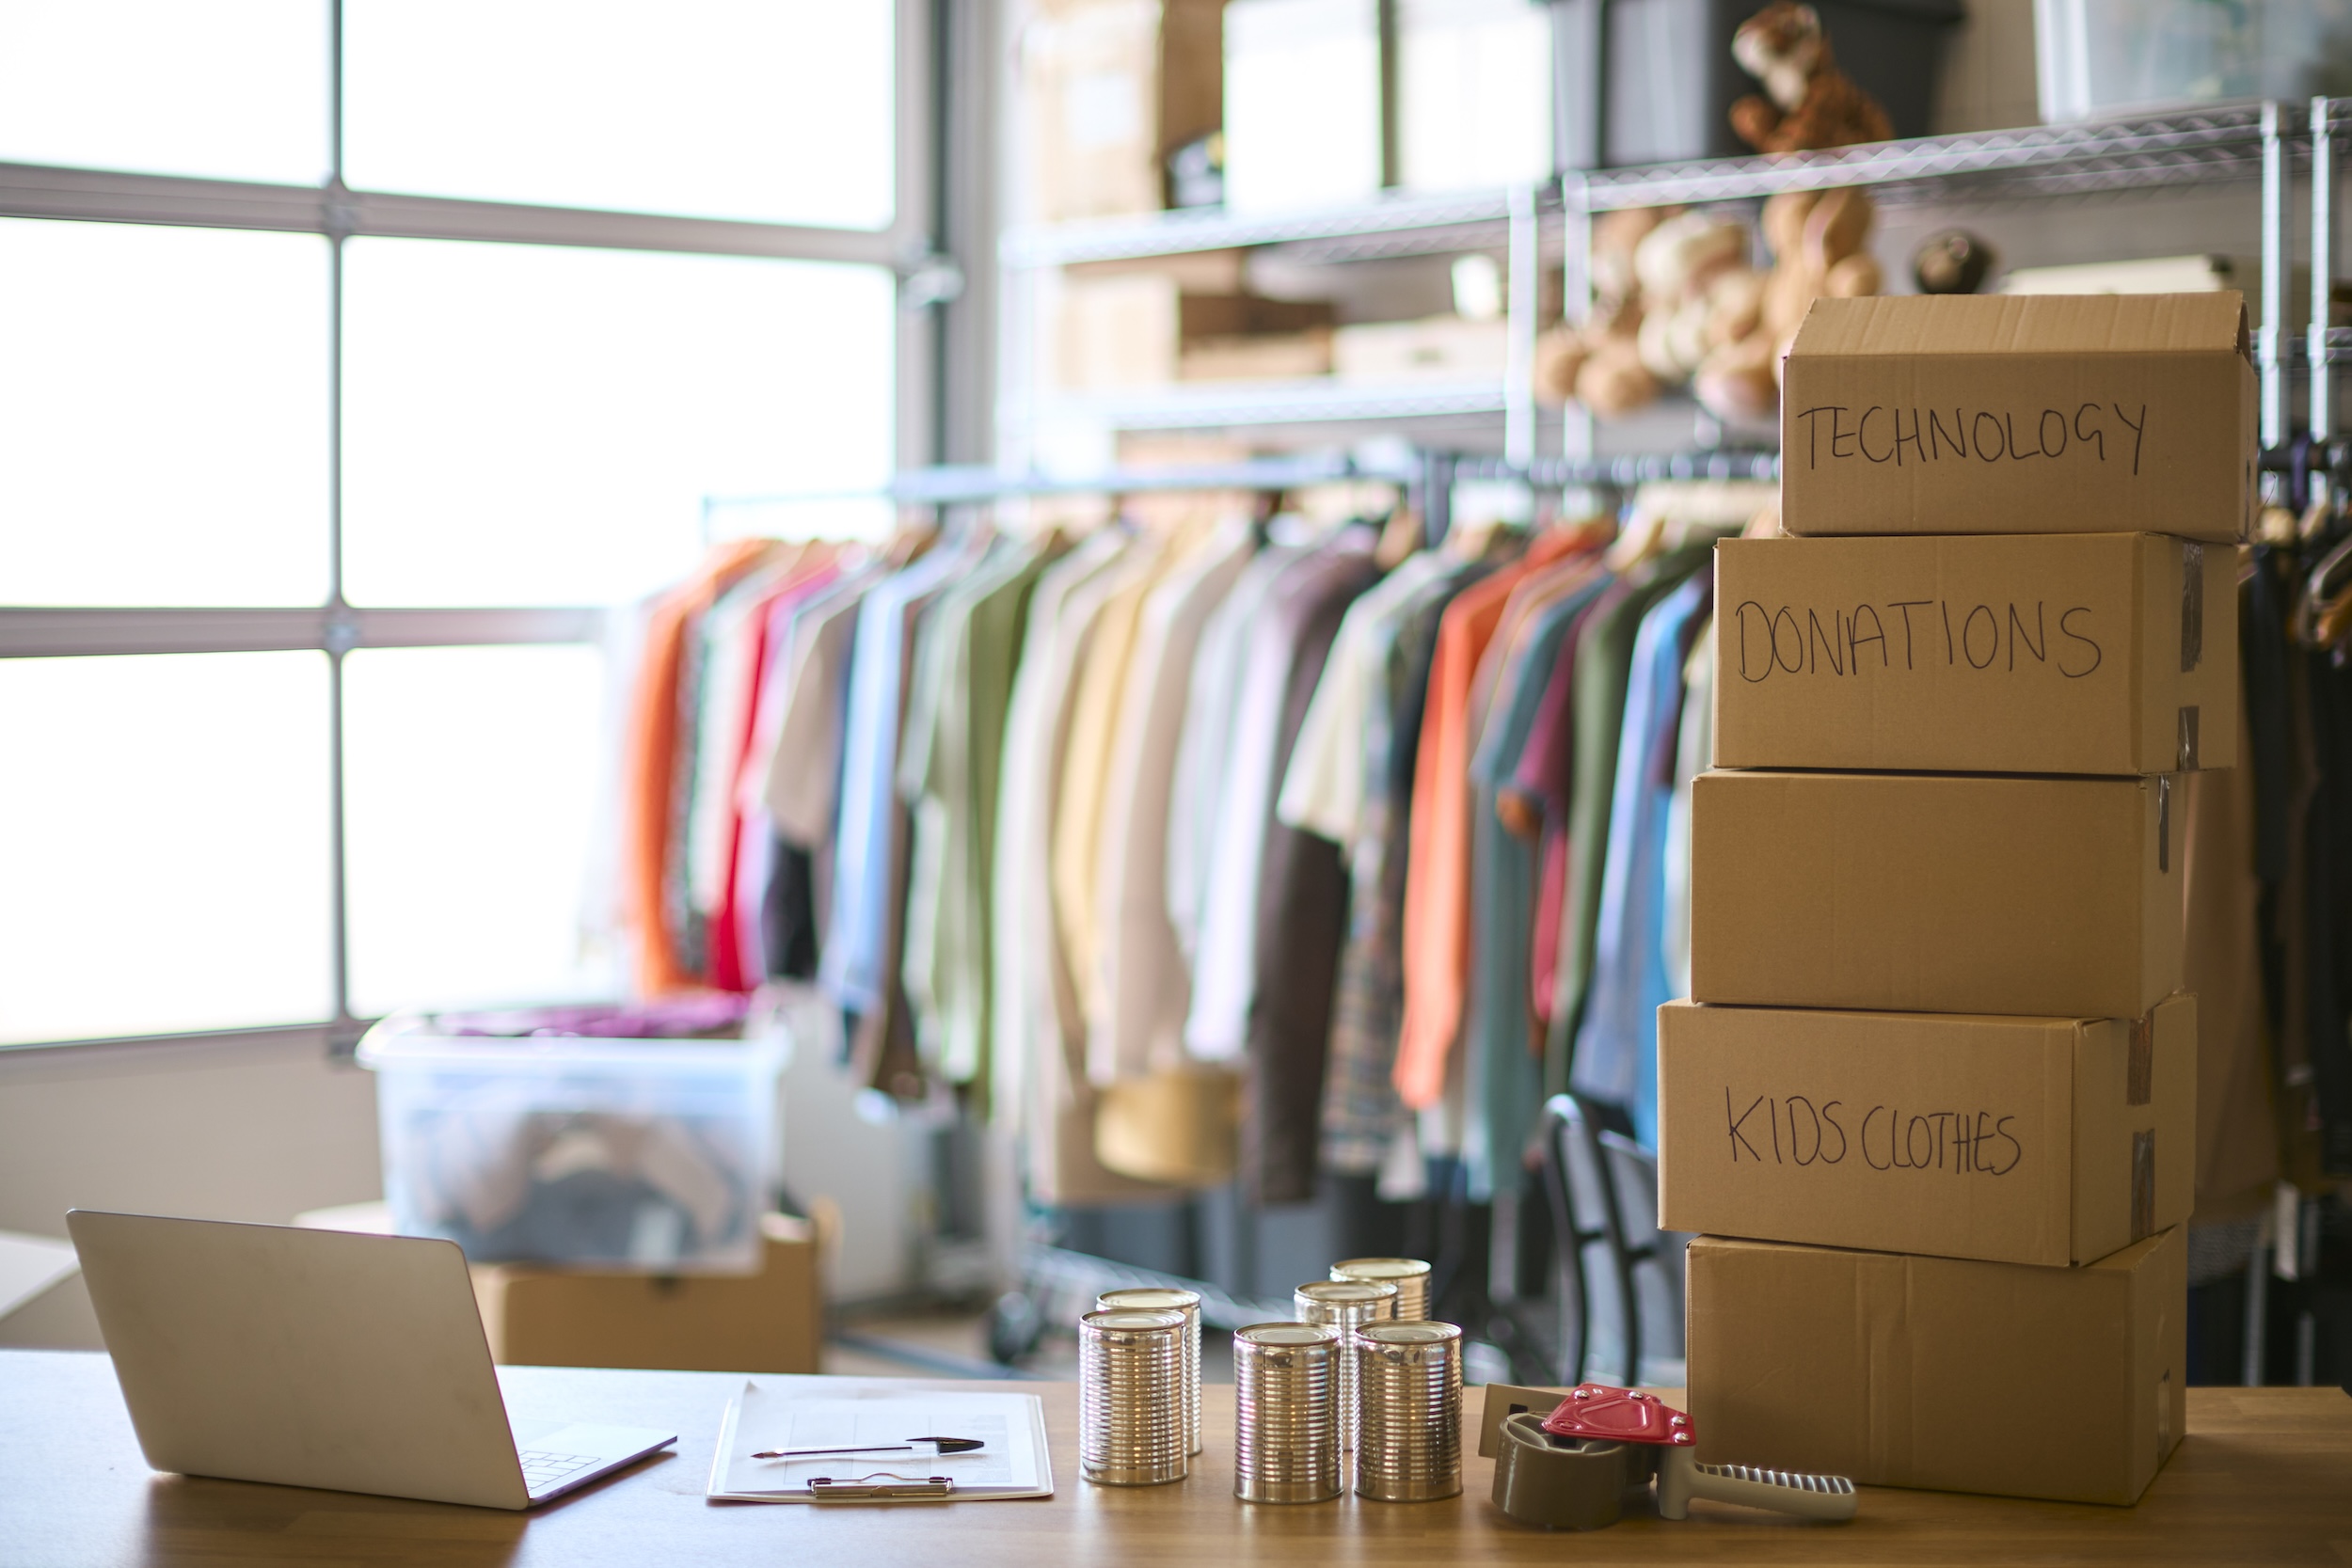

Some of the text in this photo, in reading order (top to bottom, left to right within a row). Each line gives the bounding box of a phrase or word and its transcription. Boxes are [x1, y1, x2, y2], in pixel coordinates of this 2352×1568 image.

[1797, 403, 2146, 476] TECHNOLOGY
[1736, 600, 2102, 683] DONATIONS
[1725, 1085, 2022, 1176] KIDS CLOTHES
